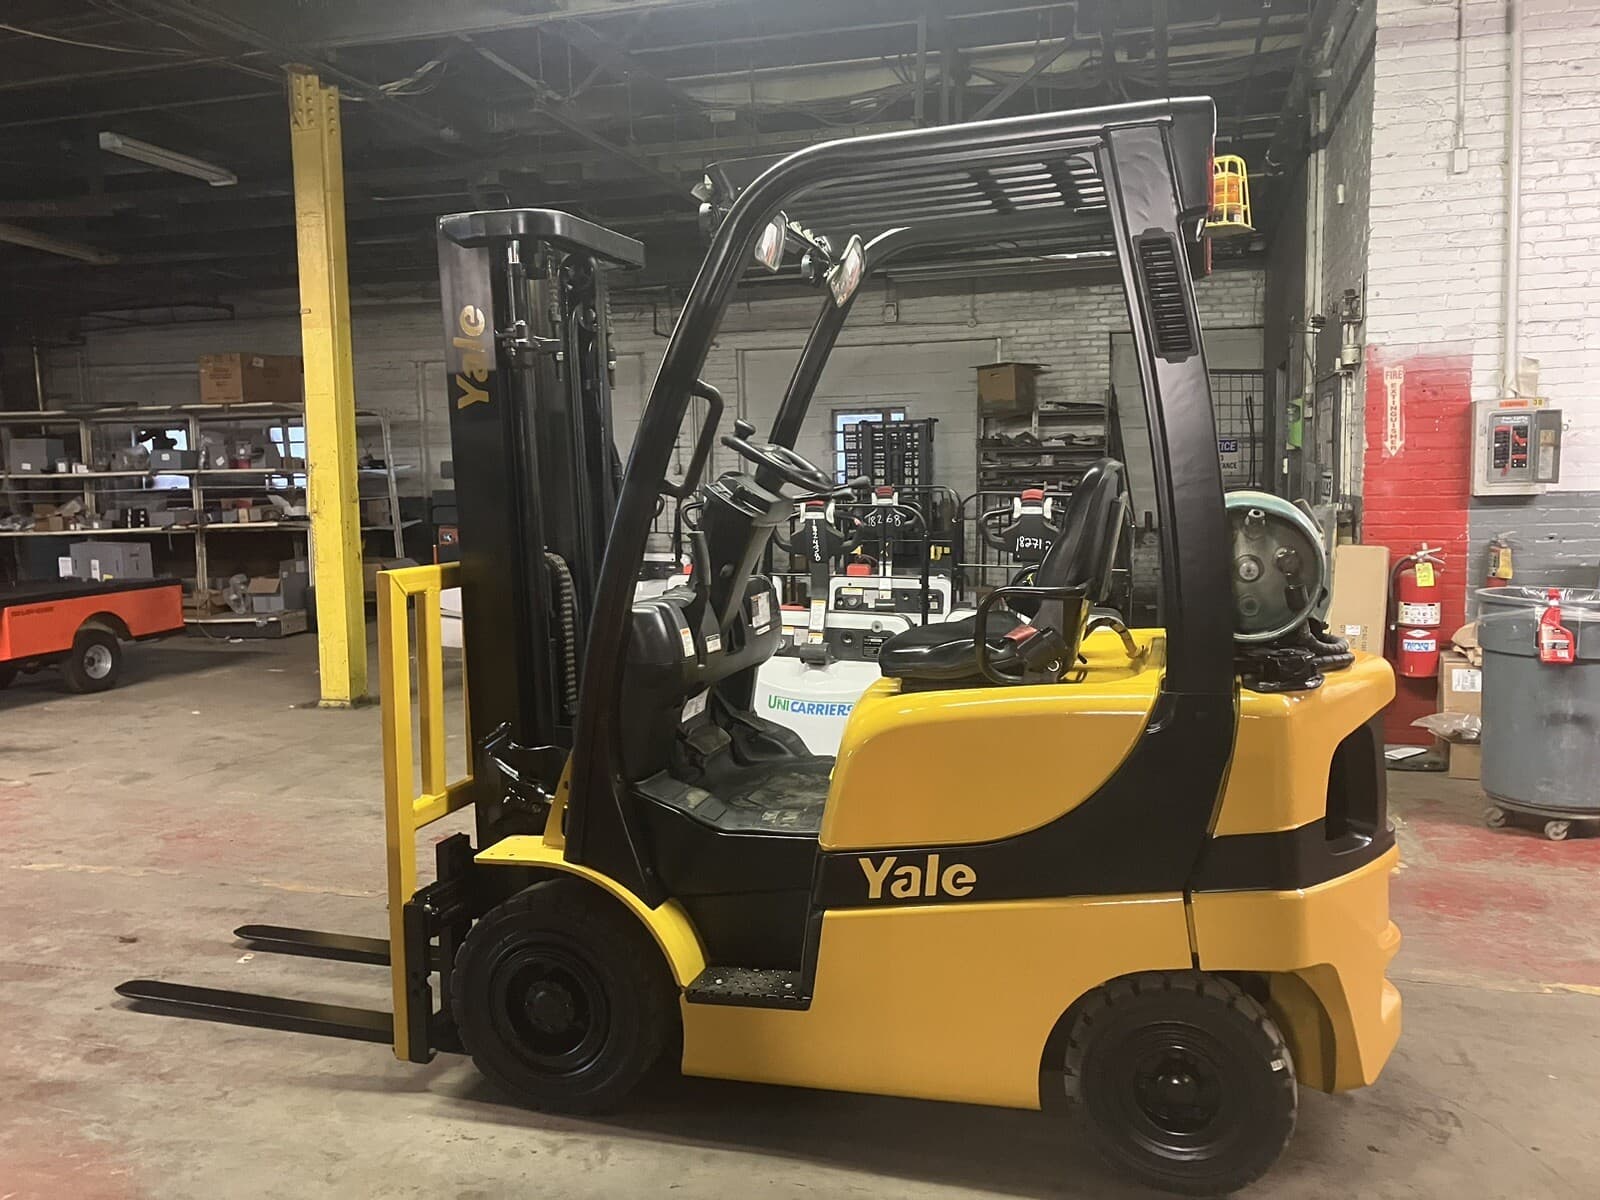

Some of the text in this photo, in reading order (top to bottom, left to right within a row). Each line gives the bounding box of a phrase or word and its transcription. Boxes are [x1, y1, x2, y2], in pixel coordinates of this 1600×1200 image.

[453, 304, 489, 409] Yale
[1385, 370, 1403, 380] FIRE
[1390, 383, 1398, 450] EXTINGUISHER
[858, 853, 977, 899] Yale
